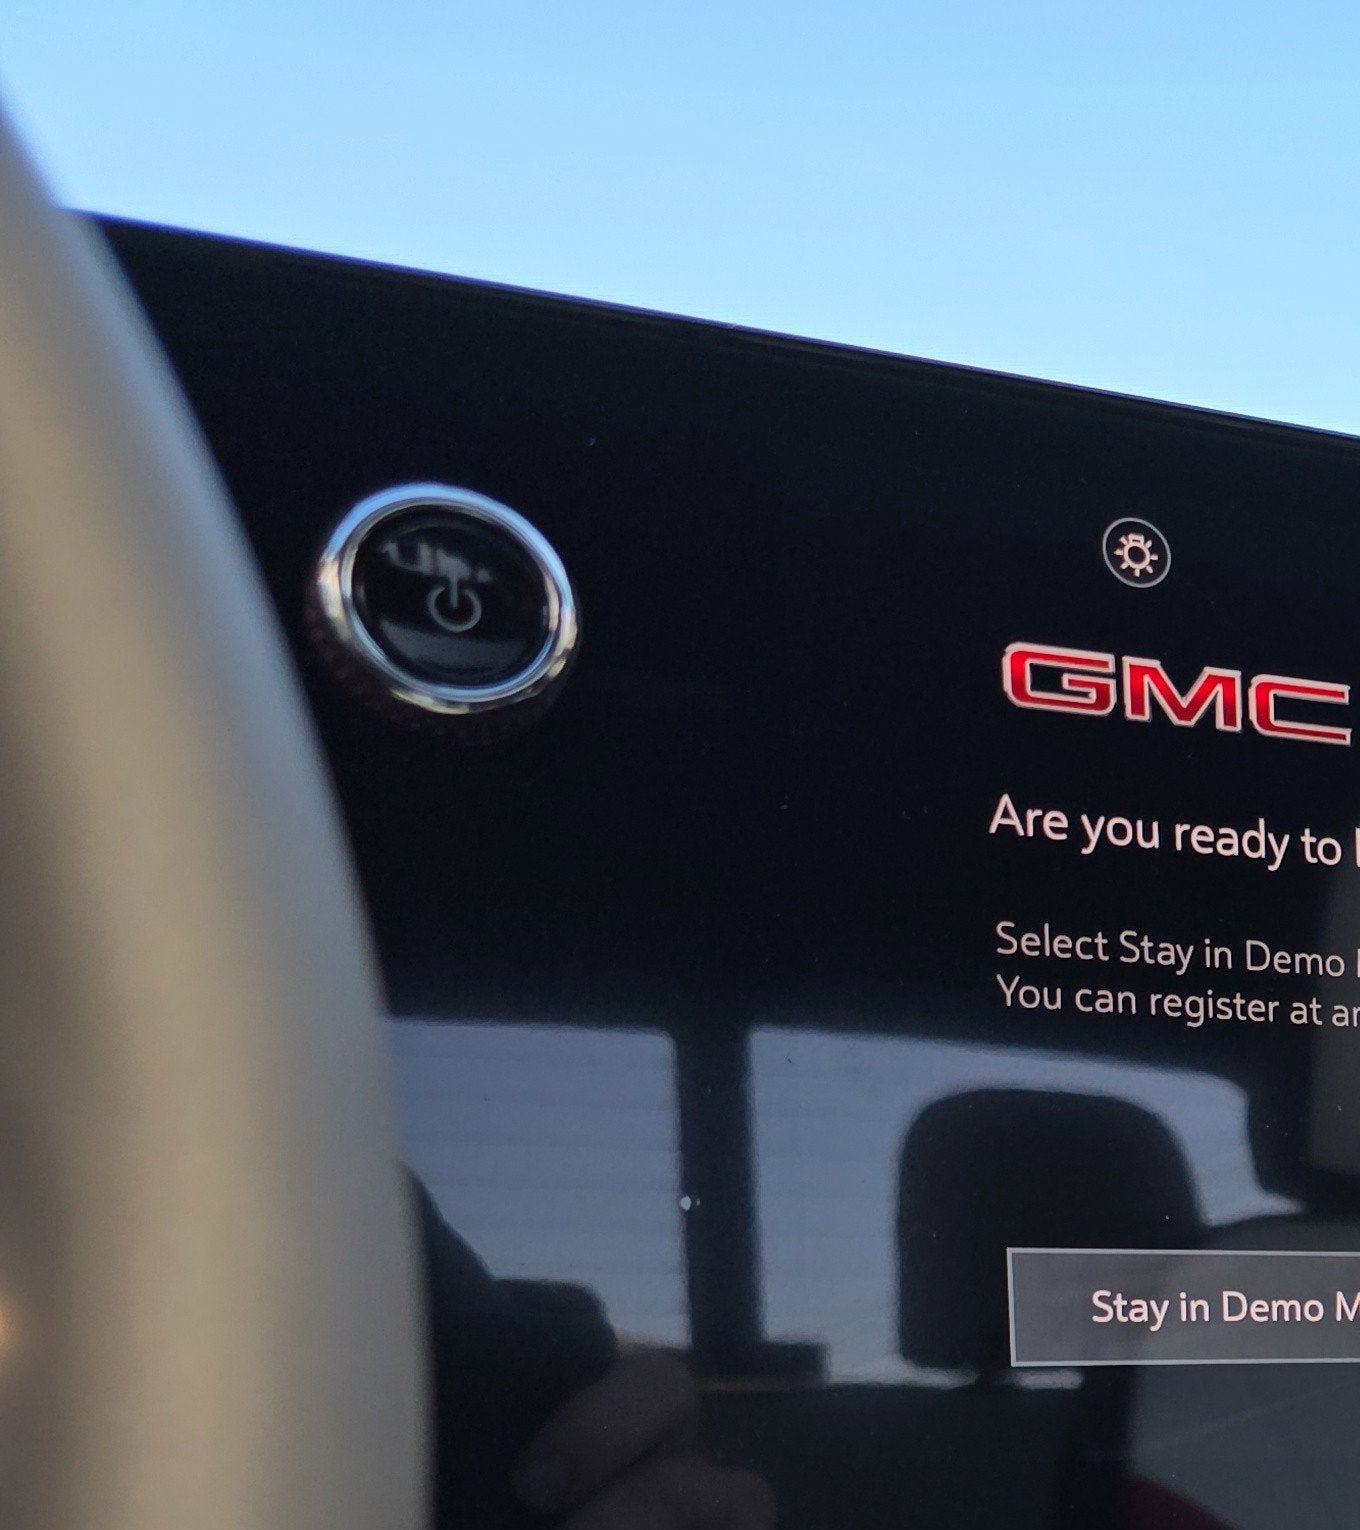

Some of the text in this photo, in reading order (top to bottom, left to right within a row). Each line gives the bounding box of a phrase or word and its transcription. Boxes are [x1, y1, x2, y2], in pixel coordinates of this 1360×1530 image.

[1001, 641, 1352, 746] GMC
[989, 793, 1069, 842] Are
[1080, 812, 1160, 856] you
[1174, 816, 1290, 873] ready
[1300, 826, 1342, 867] to
[996, 920, 1109, 963] Select
[1120, 929, 1195, 977] Stay
[1204, 937, 1233, 970] in
[1246, 939, 1345, 978] Demo
[996, 973, 1062, 1012] You
[1075, 988, 1137, 1016] can
[1150, 989, 1280, 1030] register
[1290, 996, 1324, 1027] at
[1091, 1289, 1170, 1331] Stay
[1179, 1291, 1212, 1323] in
[1222, 1291, 1325, 1325] Demo
